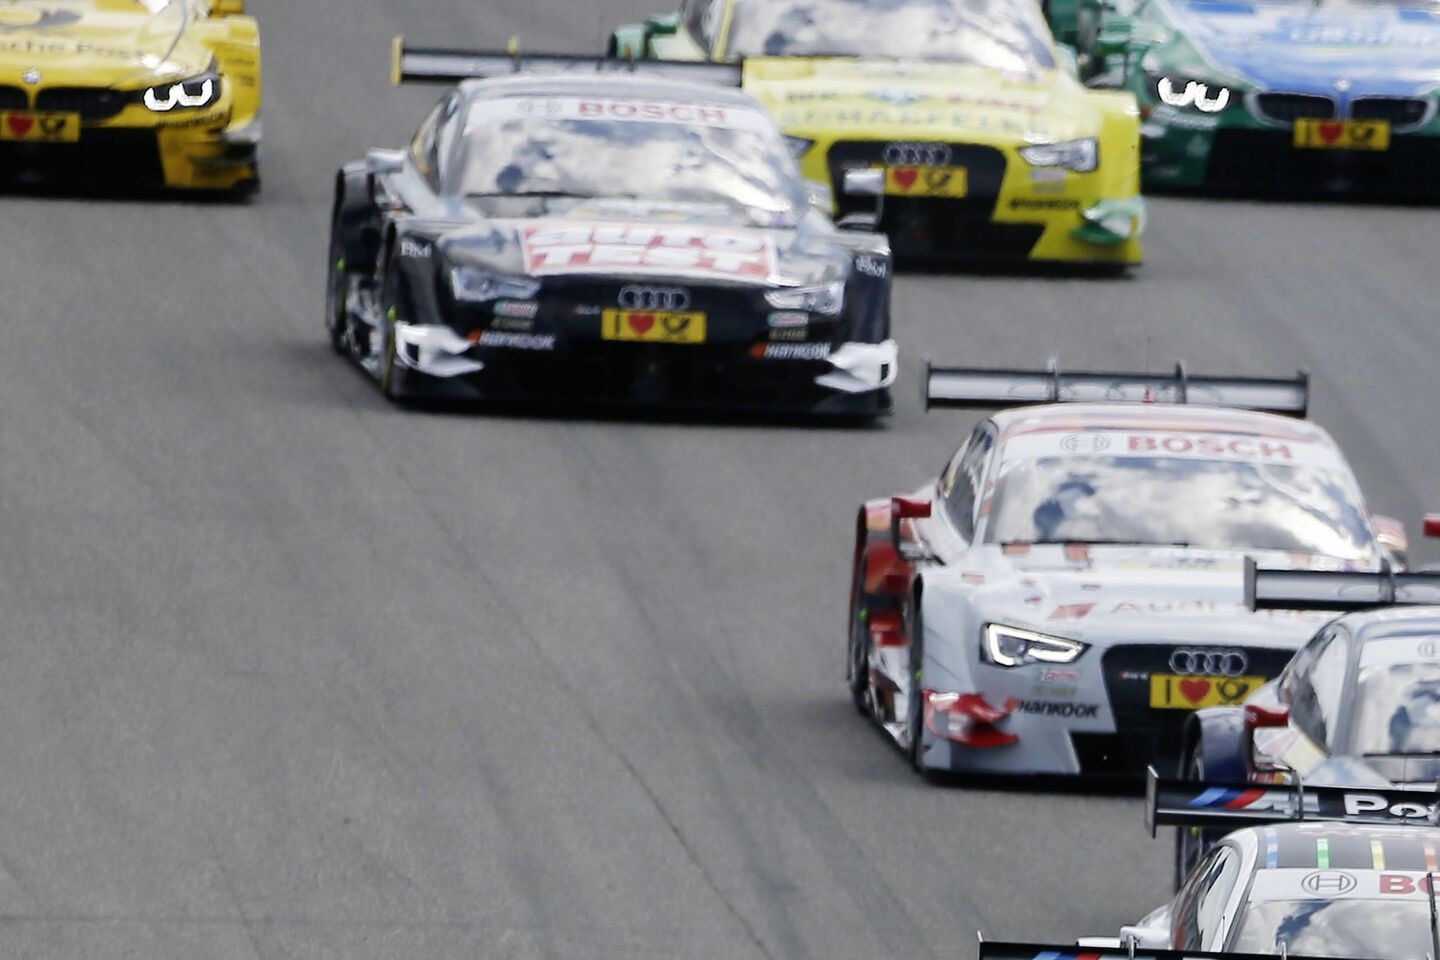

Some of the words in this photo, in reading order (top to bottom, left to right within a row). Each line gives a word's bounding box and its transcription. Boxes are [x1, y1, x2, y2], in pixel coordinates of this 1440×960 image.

[577, 101, 726, 123] BOSCH
[530, 244, 763, 272] TEST
[1127, 435, 1294, 459] BOSCH
